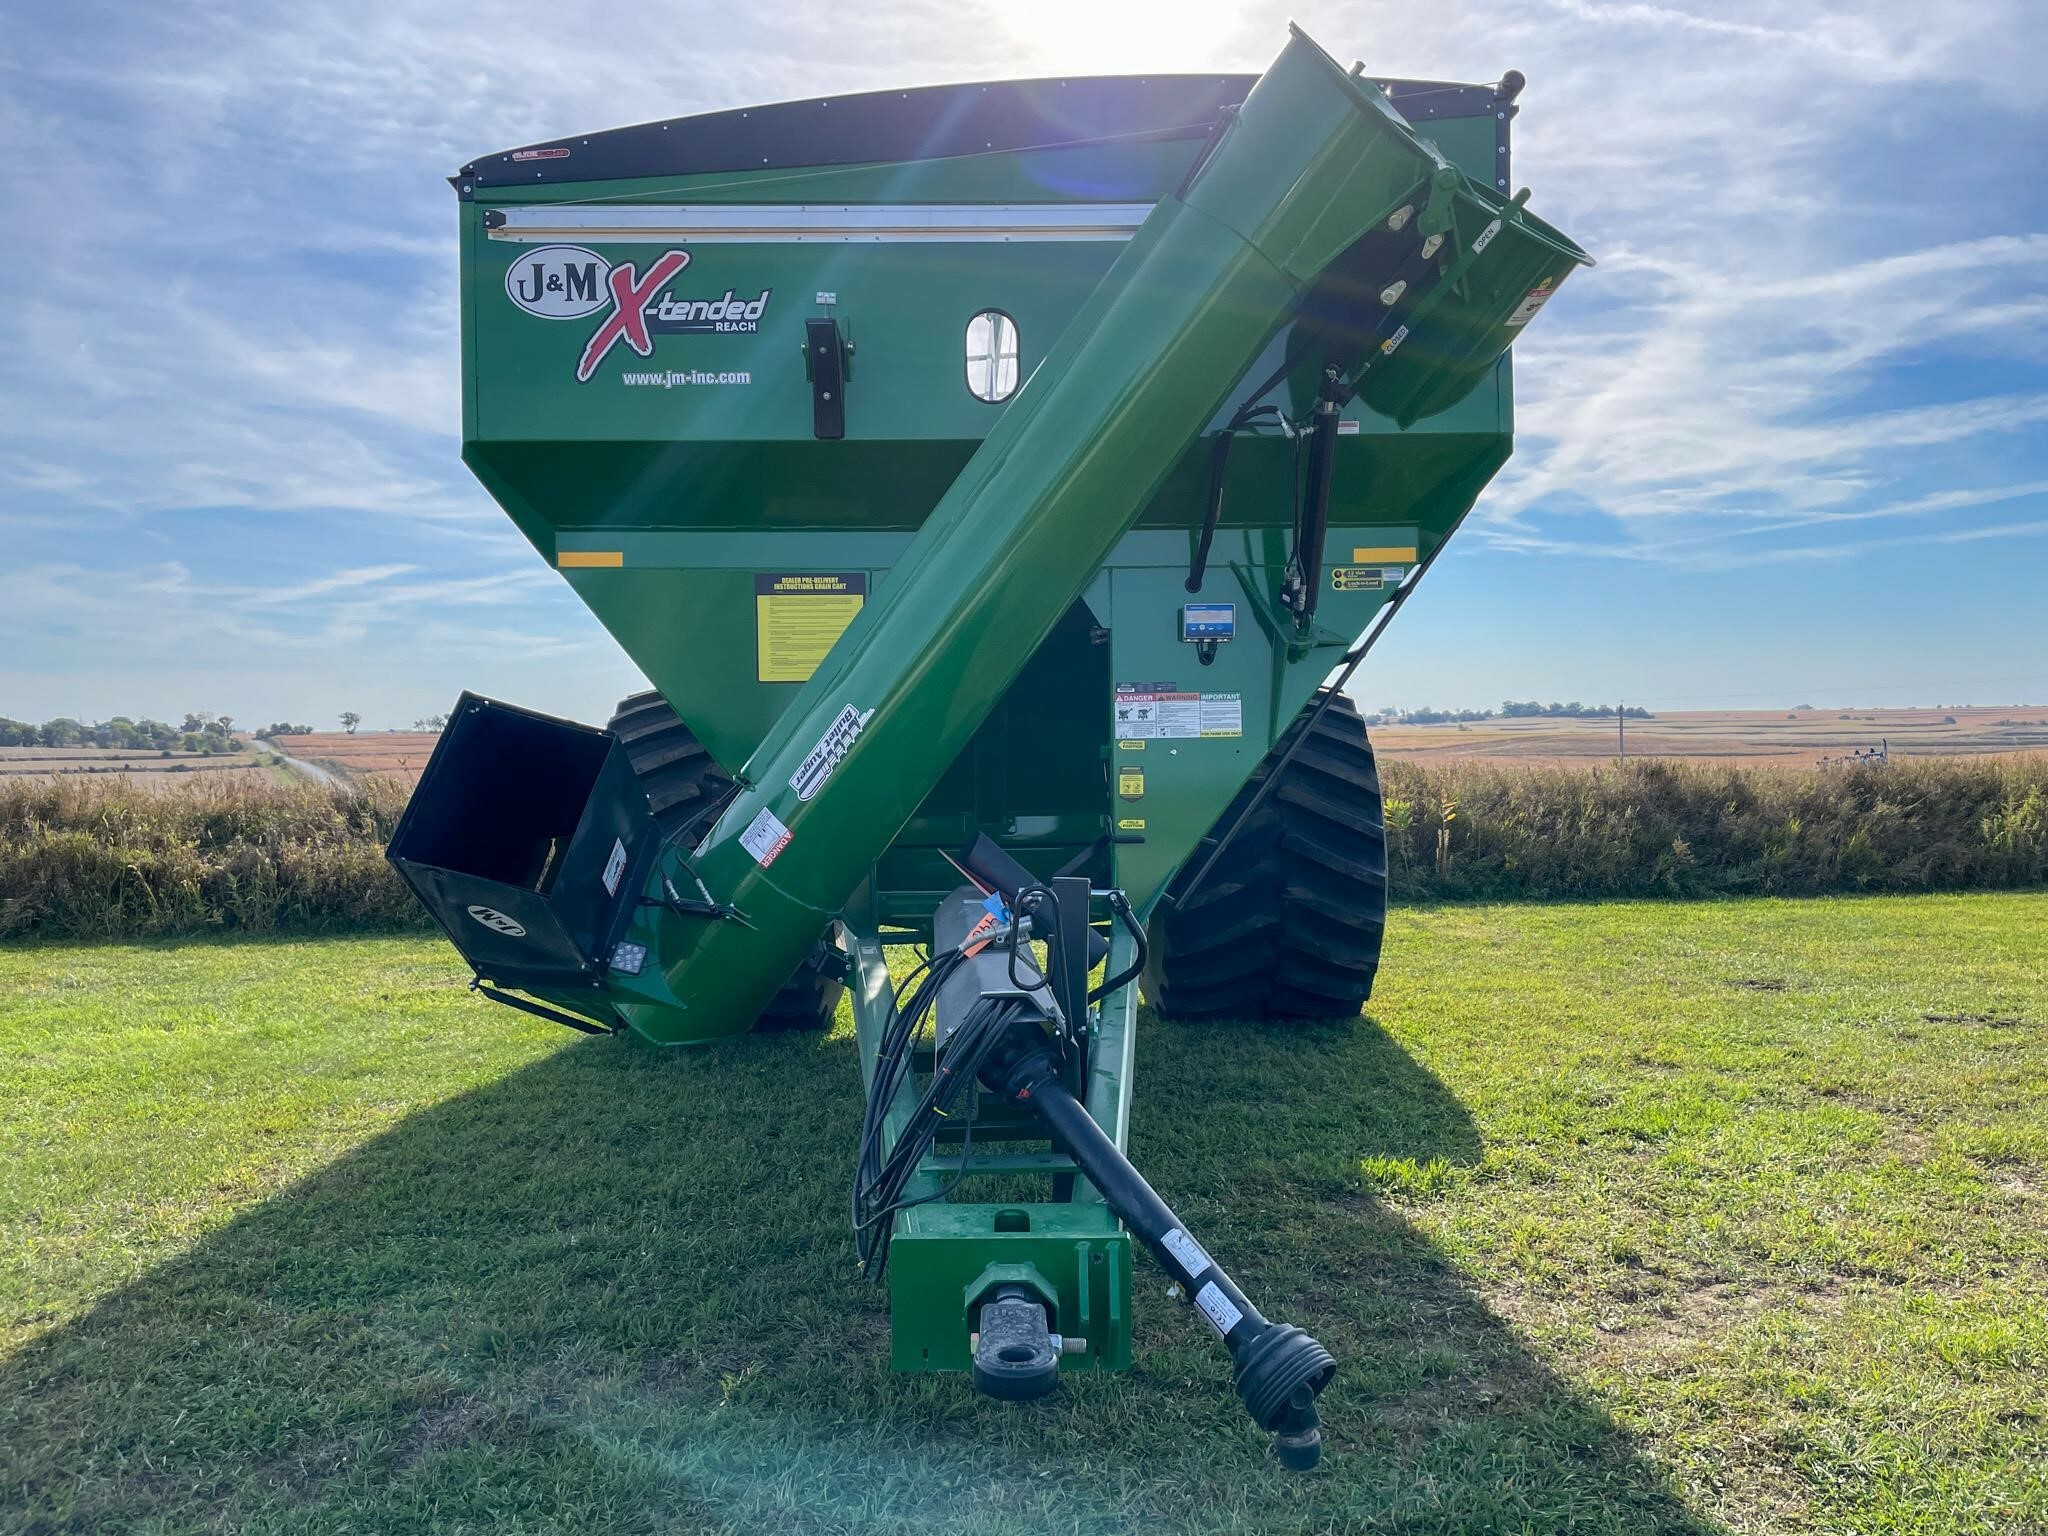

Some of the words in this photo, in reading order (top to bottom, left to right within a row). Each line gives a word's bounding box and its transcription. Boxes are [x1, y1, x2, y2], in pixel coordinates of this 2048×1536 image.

[1478, 228, 1494, 246] OPEN
[517, 262, 599, 302] J&M
[715, 321, 756, 332] REACH
[1386, 328, 1405, 351] CLOSED
[623, 370, 750, 389] www.jm-inc.com
[824, 710, 853, 748] Bullet
[796, 746, 823, 785] Auger
[762, 838, 789, 868] DANGER
[472, 908, 524, 935] J&M
